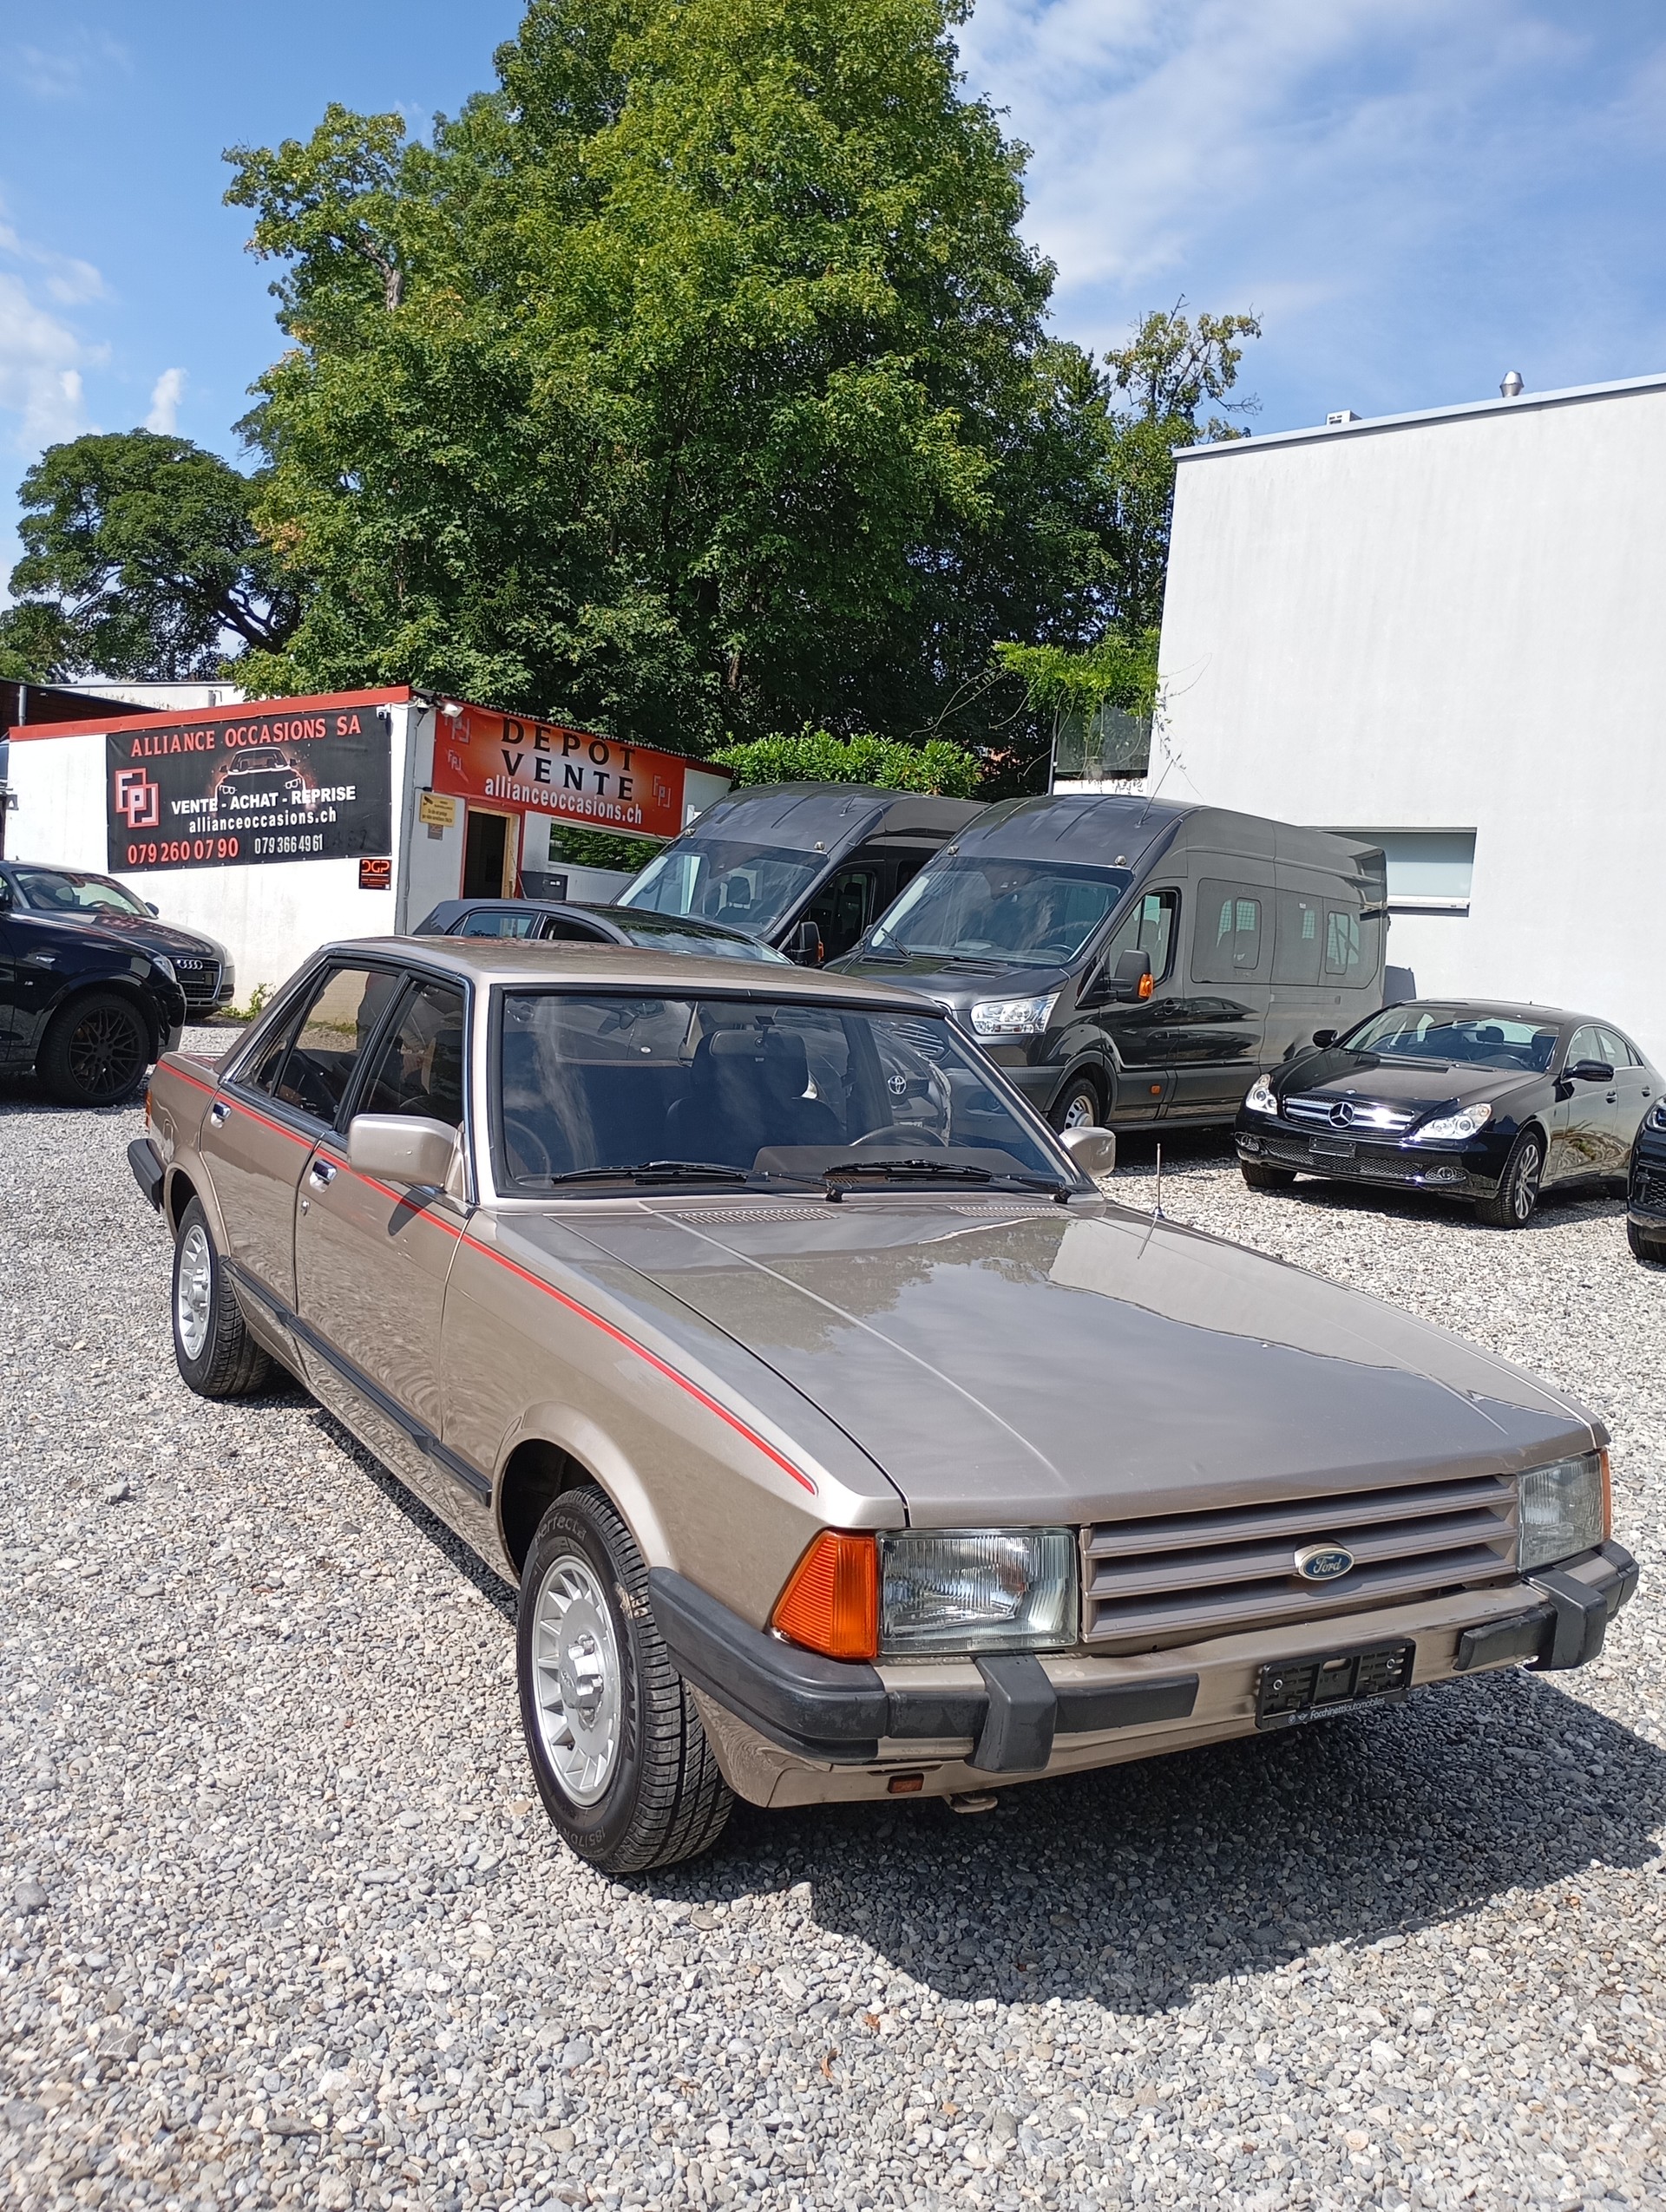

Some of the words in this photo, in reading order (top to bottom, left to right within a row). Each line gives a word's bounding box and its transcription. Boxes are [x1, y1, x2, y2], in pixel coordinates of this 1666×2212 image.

[131, 730, 216, 758] ALLIANCE
[225, 717, 327, 749] OCCASIONS
[337, 714, 362, 736] SA
[501, 749, 634, 802] VENTE
[171, 797, 219, 815] VENTE
[229, 791, 279, 810] ACHAT
[291, 785, 357, 806] REPRISE
[484, 775, 643, 824] allianceoccasions.ch
[188, 806, 338, 834] allianceoccasions.ch
[128, 843, 157, 865] 079
[161, 840, 190, 862] 260
[193, 838, 213, 861] 07
[218, 836, 239, 858] 90
[1313, 1554, 1341, 1574] Ford
